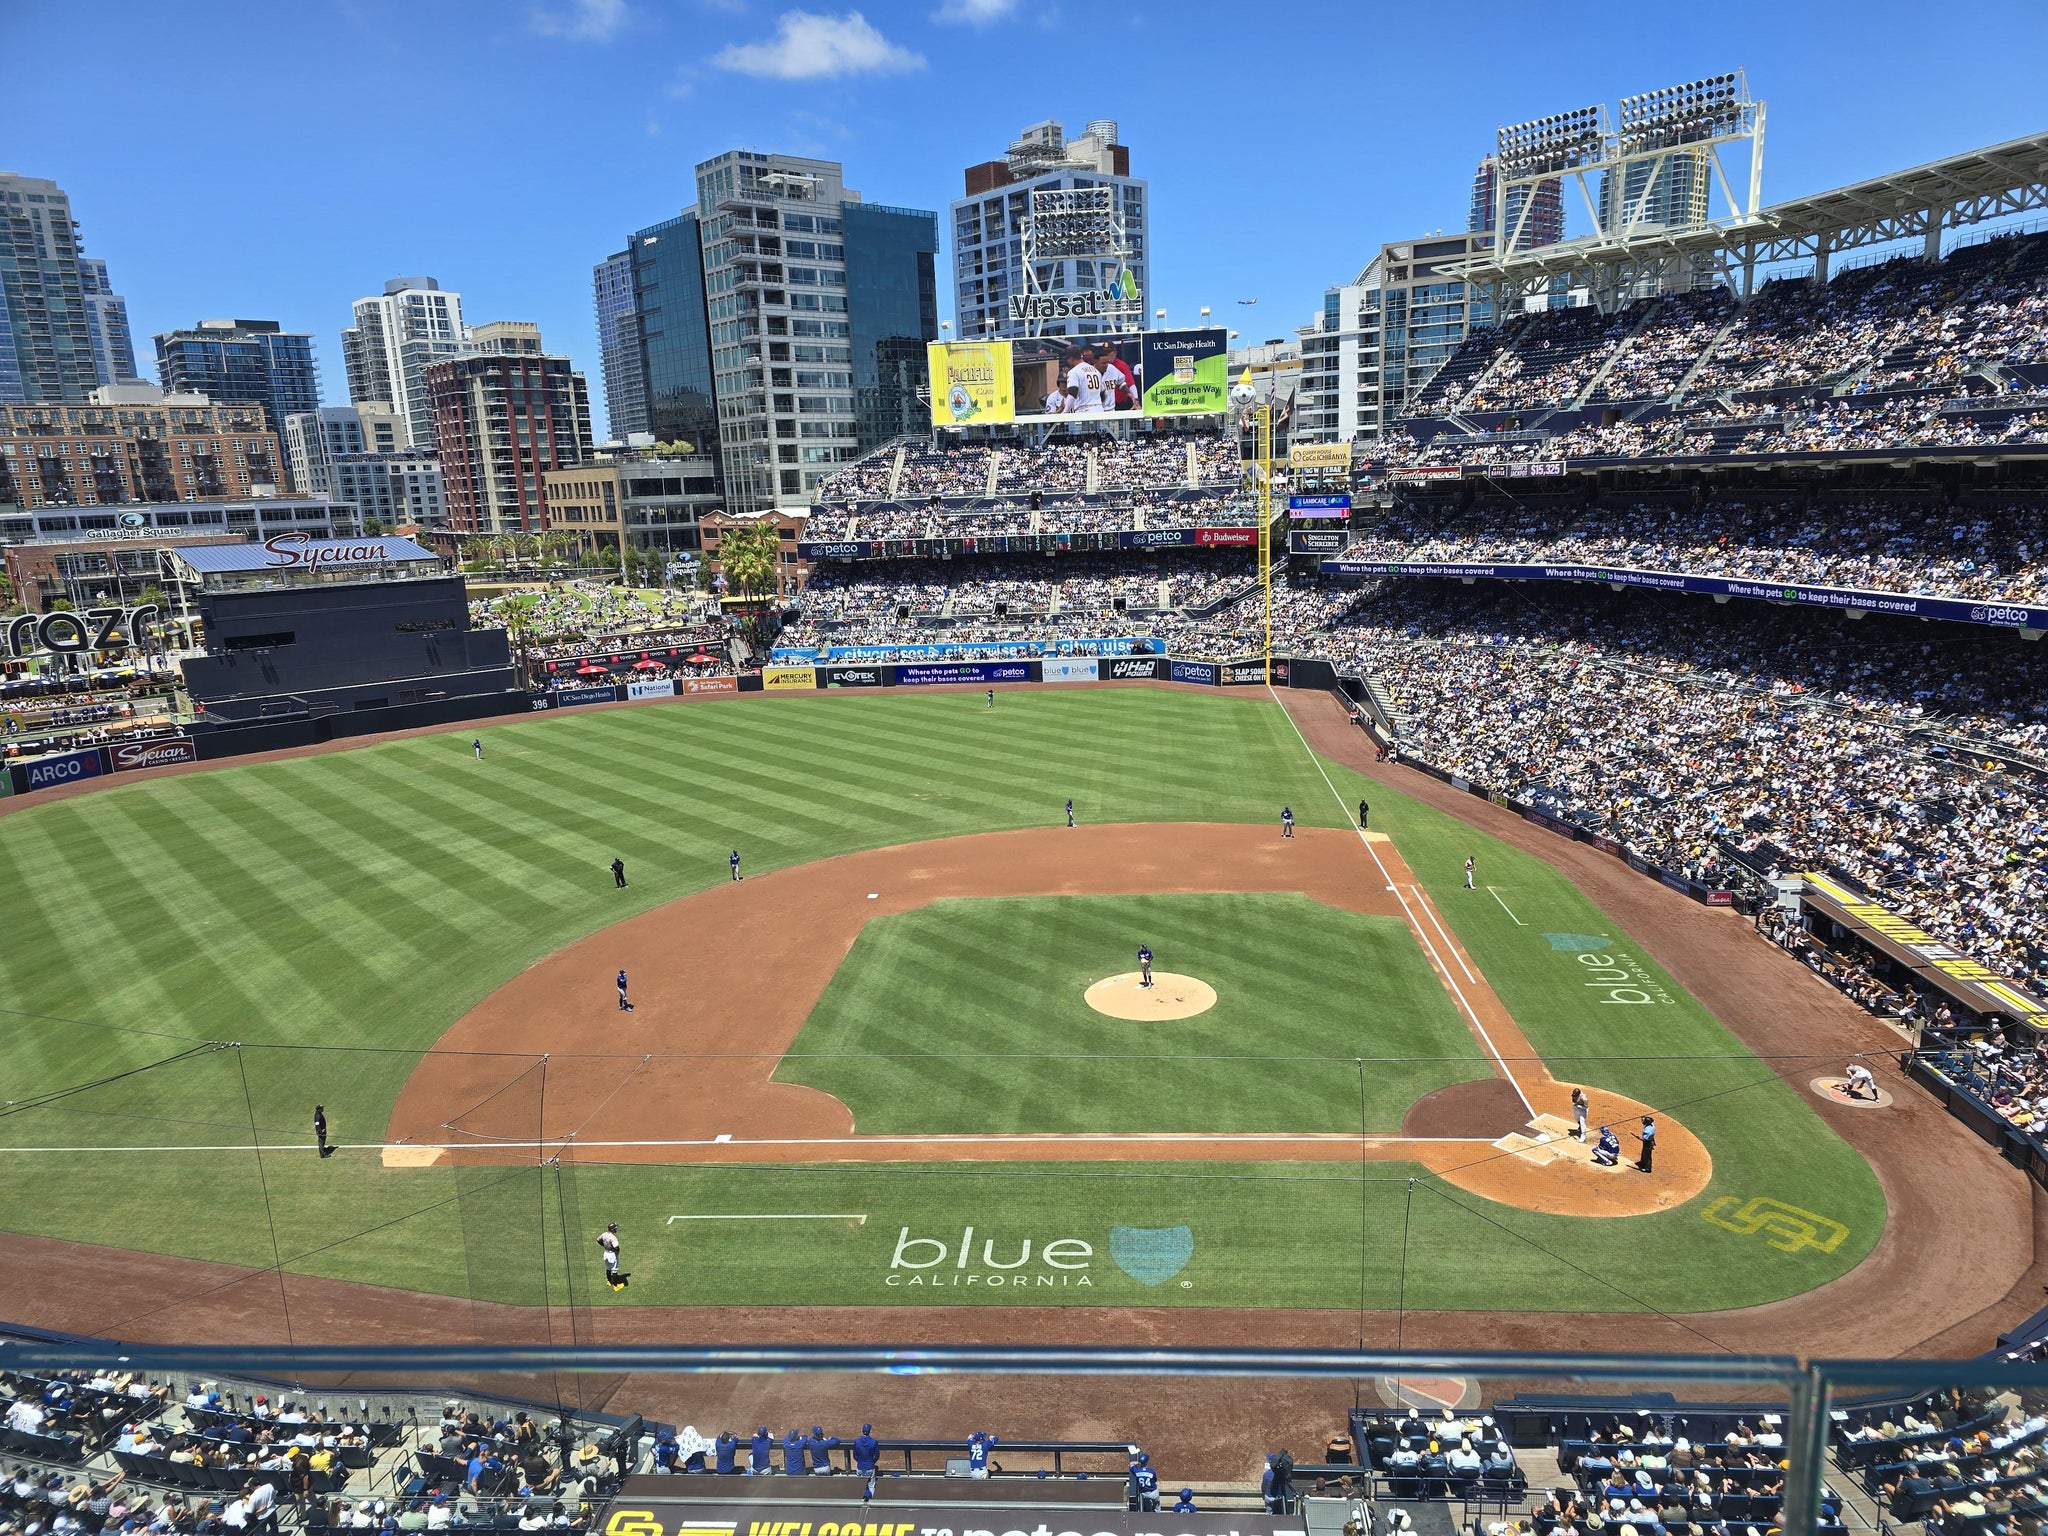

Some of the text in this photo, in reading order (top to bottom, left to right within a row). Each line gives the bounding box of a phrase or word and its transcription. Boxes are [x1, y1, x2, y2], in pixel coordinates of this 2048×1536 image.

[1012, 290, 1101, 319] Viasat
[1153, 339, 1216, 351] UC San Diego Health
[1086, 374, 1100, 390] 30
[1155, 385, 1220, 396] Leading the Way
[1317, 453, 1347, 461] ICHIBANYA
[1388, 469, 1427, 481] Tarantino
[1530, 463, 1560, 476] $15,325
[86, 527, 181, 539] Gallagher Square
[1147, 531, 1182, 544] petco
[1213, 532, 1250, 542] Budweiser
[263, 532, 390, 575] Sycuan
[825, 543, 858, 556] petco
[667, 561, 701, 569] Gallagher
[1339, 564, 1361, 572] Where
[1361, 564, 1372, 572] the
[1372, 565, 1387, 574] pets
[1388, 565, 1399, 573] GO
[1408, 566, 1425, 575] keep
[1426, 566, 1442, 574] their
[1443, 567, 1463, 575] bases
[1464, 567, 1494, 575] covered
[672, 567, 698, 576] Square
[1545, 568, 1685, 588] Where the pets GO to keep their bases covered
[1727, 583, 1917, 612] Where the pets GO to keep their bases covered
[1987, 606, 2028, 621] petco
[7, 603, 158, 657] razr
[1044, 666, 1062, 674] blue
[1071, 666, 1089, 674] blue
[1127, 661, 1155, 671] H2O
[1184, 665, 1212, 678] petco
[1234, 668, 1250, 676] SLAP
[1250, 667, 1266, 675] SOME
[833, 670, 875, 682] EVOTEK
[957, 674, 985, 682] covered
[1002, 668, 1025, 677] petco
[644, 683, 671, 692] National
[700, 682, 718, 690] Safari
[532, 698, 548, 710] 396
[118, 745, 188, 767] Sycuan
[148, 755, 191, 765] CASINO RESORT
[31, 760, 81, 784] ARCO
[1577, 953, 1656, 1004] blue
[1617, 953, 1676, 1005] CALIFORNIA
[890, 1226, 1093, 1269] blue
[885, 1275, 1093, 1286] CALIFORNIA
[970, 1449, 983, 1461] 72
